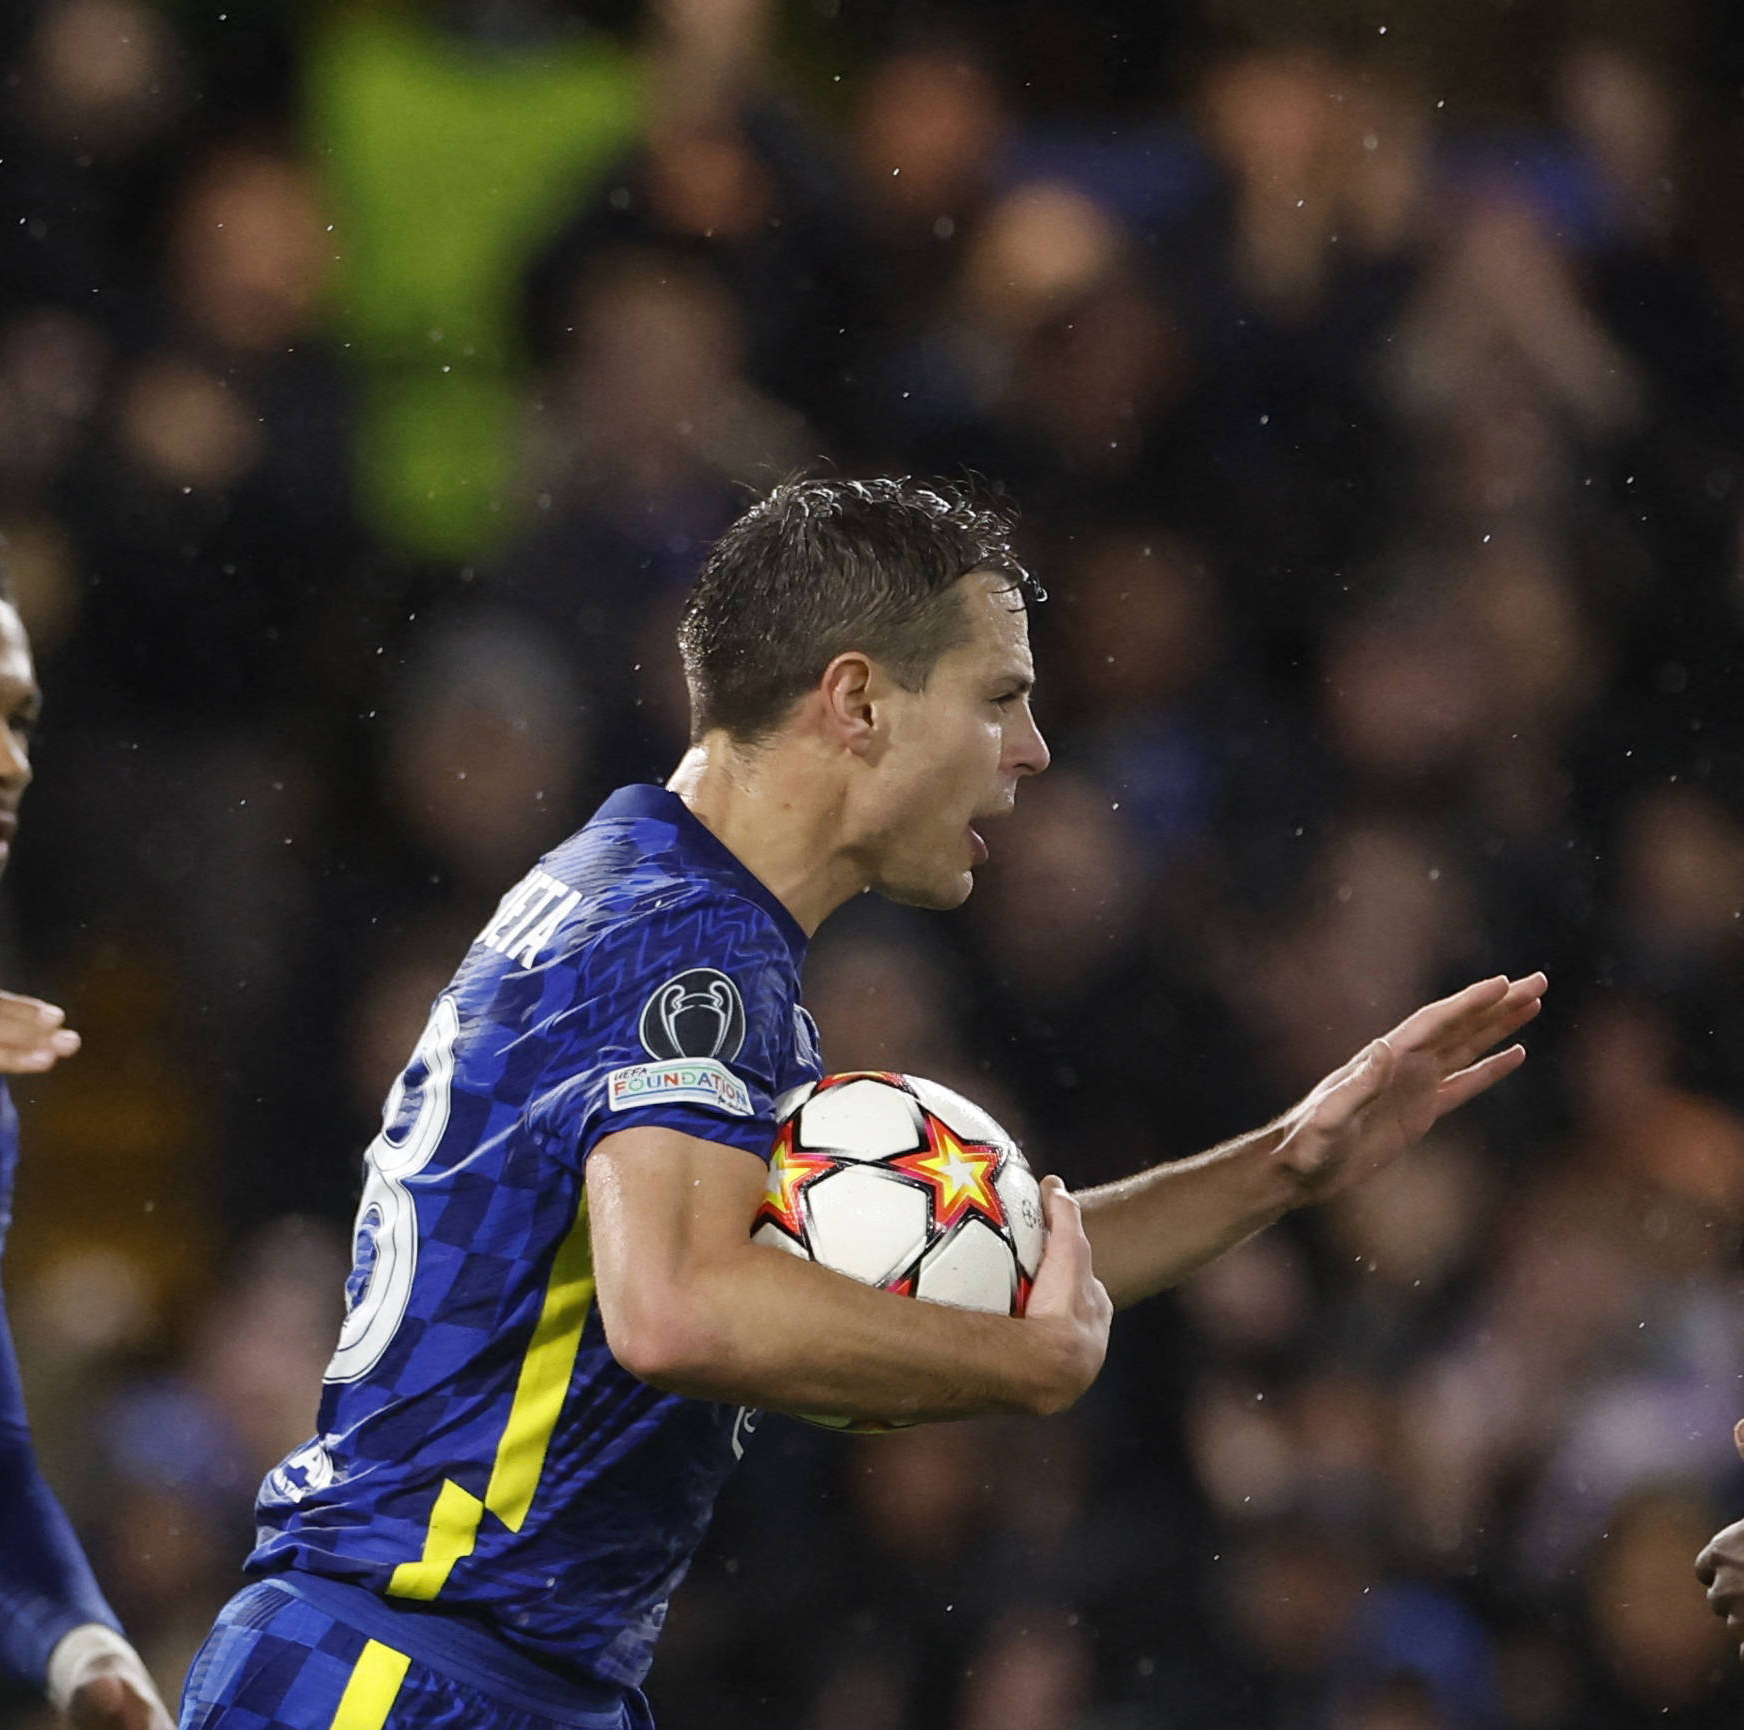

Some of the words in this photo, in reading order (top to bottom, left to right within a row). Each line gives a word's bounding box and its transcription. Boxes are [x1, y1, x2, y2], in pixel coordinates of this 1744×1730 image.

[473, 868, 583, 970] ETA
[614, 1066, 647, 1081] UEFA
[614, 1071, 747, 1105] FOUNDATION
